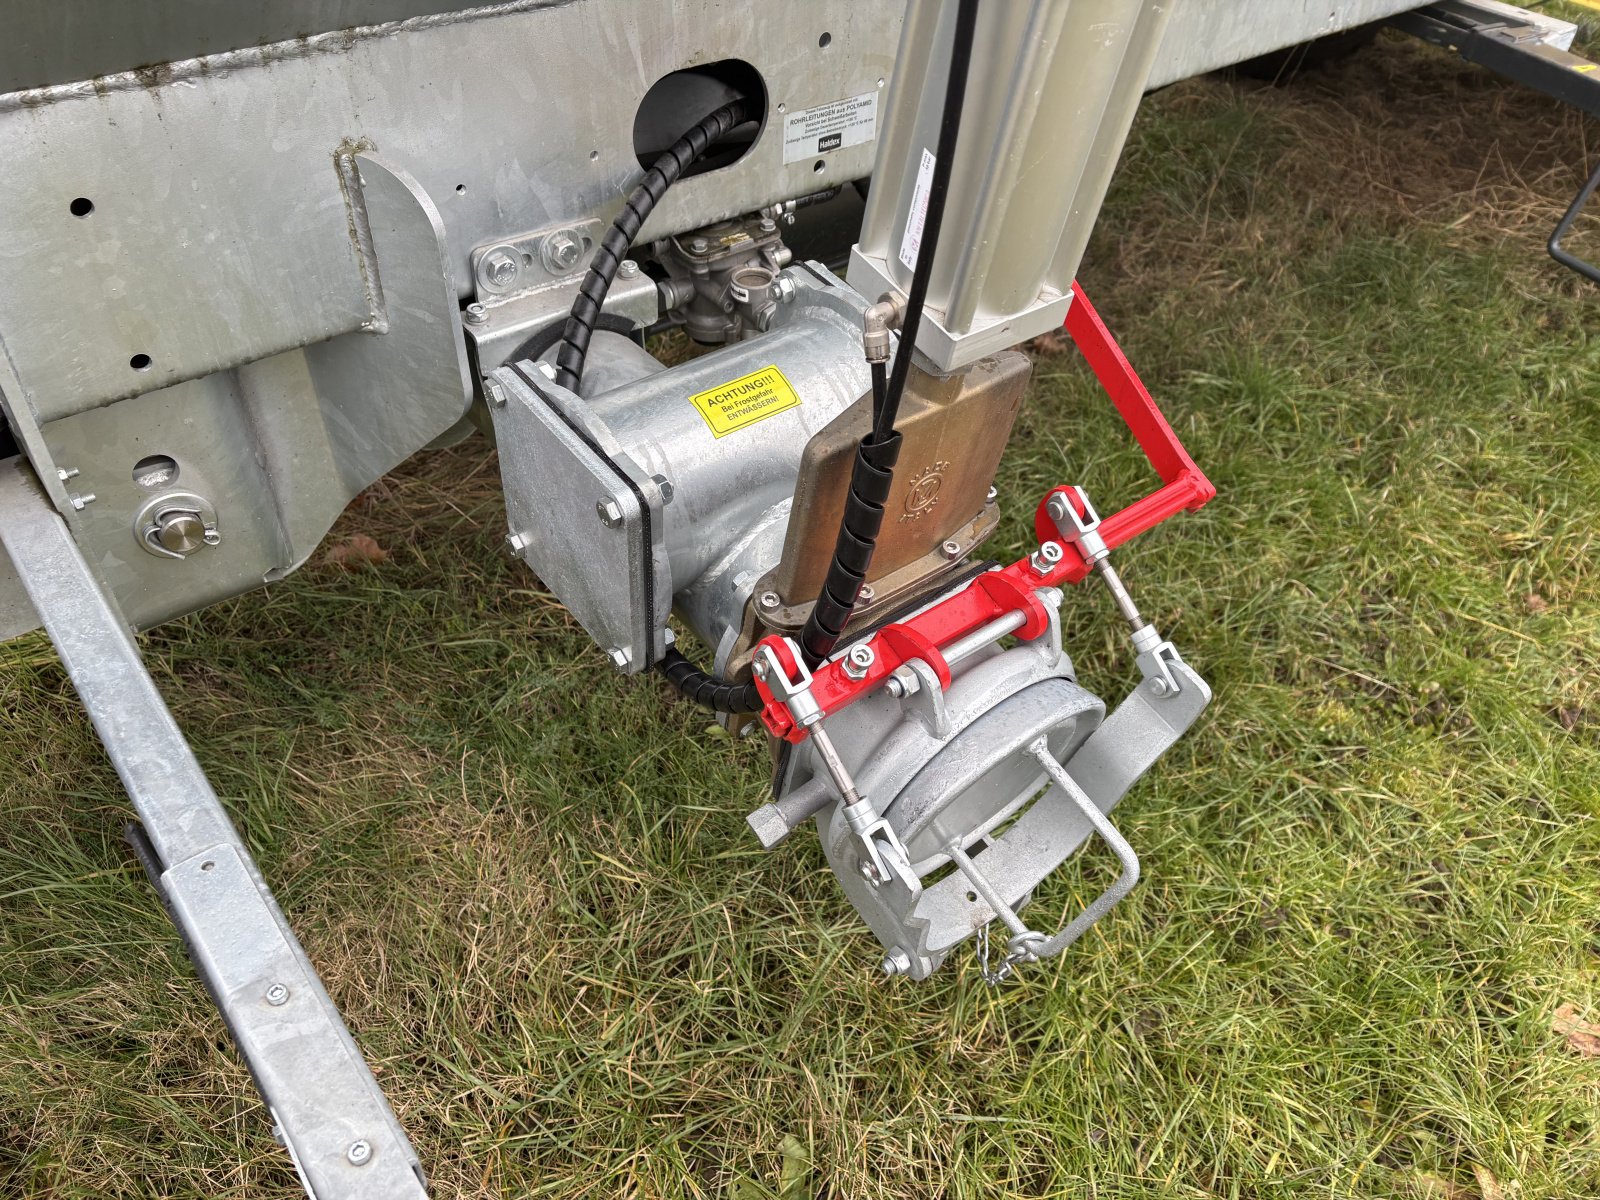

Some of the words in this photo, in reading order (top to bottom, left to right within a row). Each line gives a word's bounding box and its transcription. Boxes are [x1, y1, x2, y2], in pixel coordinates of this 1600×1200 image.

[790, 109, 835, 125] ROHRLEITUNGEN
[820, 138, 840, 148] Haldex
[707, 375, 775, 407] ACHTUNG!!!
[721, 405, 734, 413] Bei
[735, 388, 774, 407] Frostgefahr
[727, 396, 779, 421] ENTWÄSSERN!
